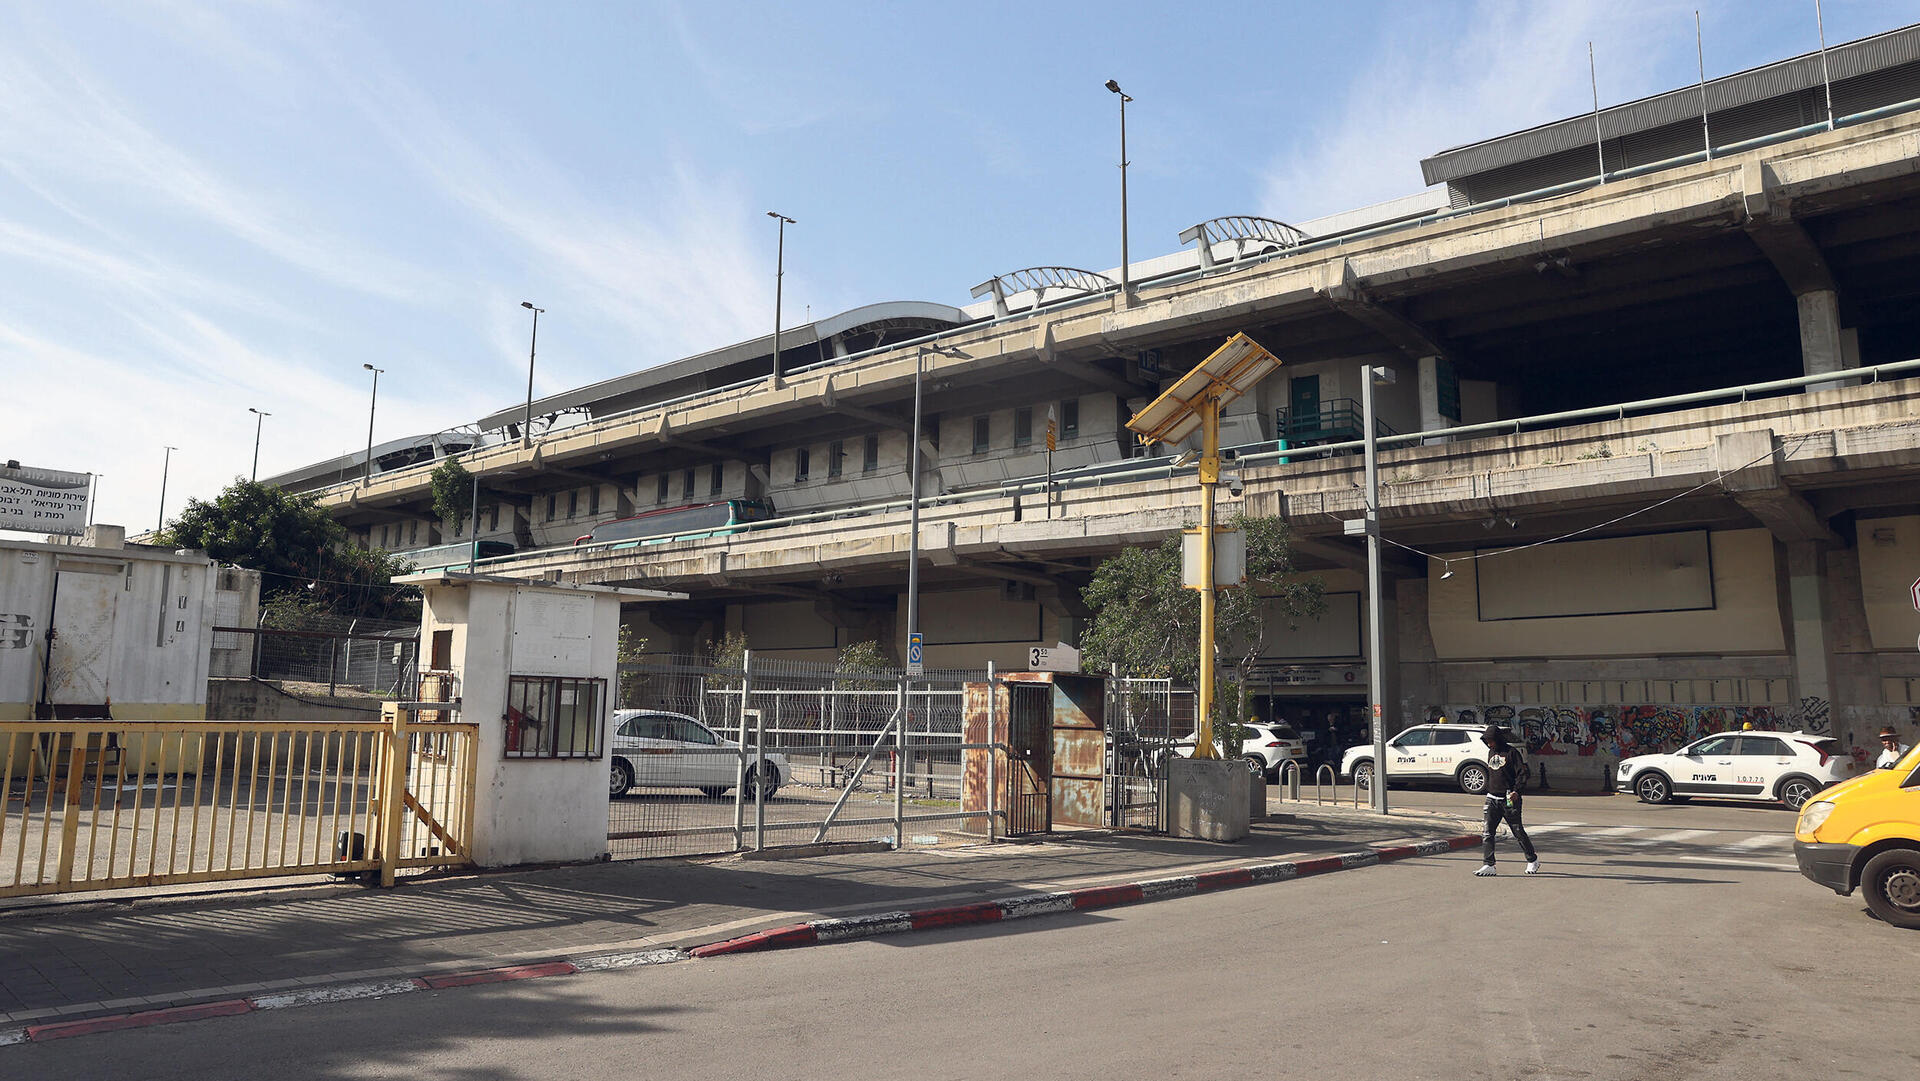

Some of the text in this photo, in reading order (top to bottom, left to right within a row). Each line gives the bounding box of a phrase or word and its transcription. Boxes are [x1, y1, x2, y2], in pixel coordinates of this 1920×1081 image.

[36, 490, 61, 499] מוניות
[63, 491, 87, 502] שירות
[31, 499, 64, 509] עזריאלי
[66, 502, 82, 511] דרך
[10, 507, 24, 515] בני
[45, 511, 65, 519] רמת
